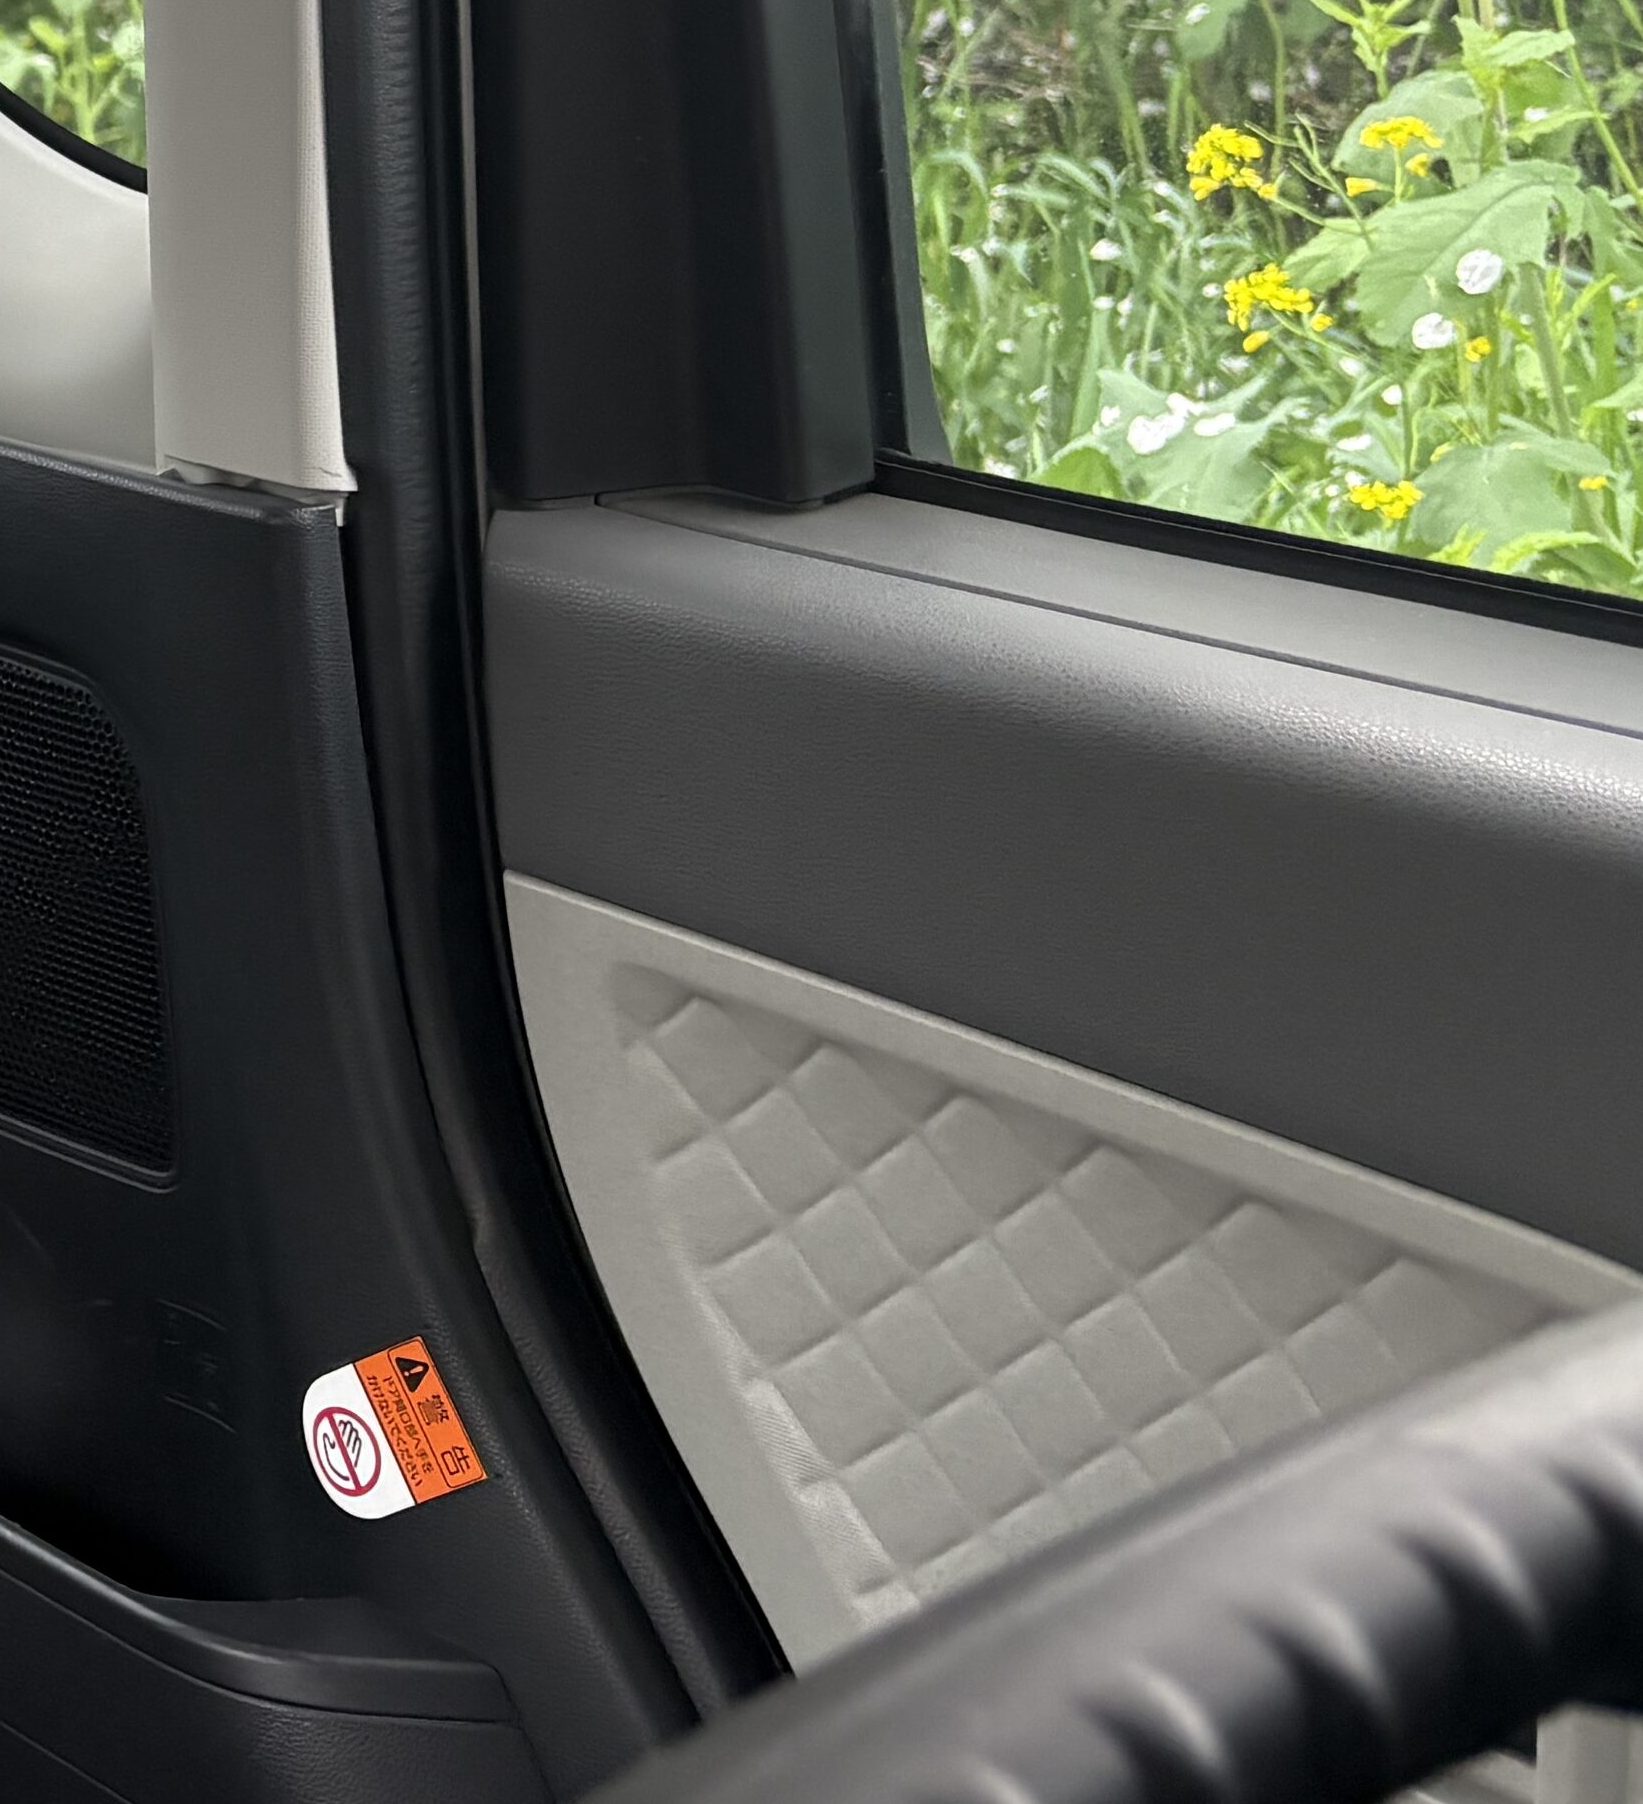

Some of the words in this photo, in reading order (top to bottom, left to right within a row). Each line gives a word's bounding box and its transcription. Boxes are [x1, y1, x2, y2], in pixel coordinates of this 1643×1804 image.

[366, 1375, 424, 1487] かけないでください
[417, 1394, 470, 1475] 警告
